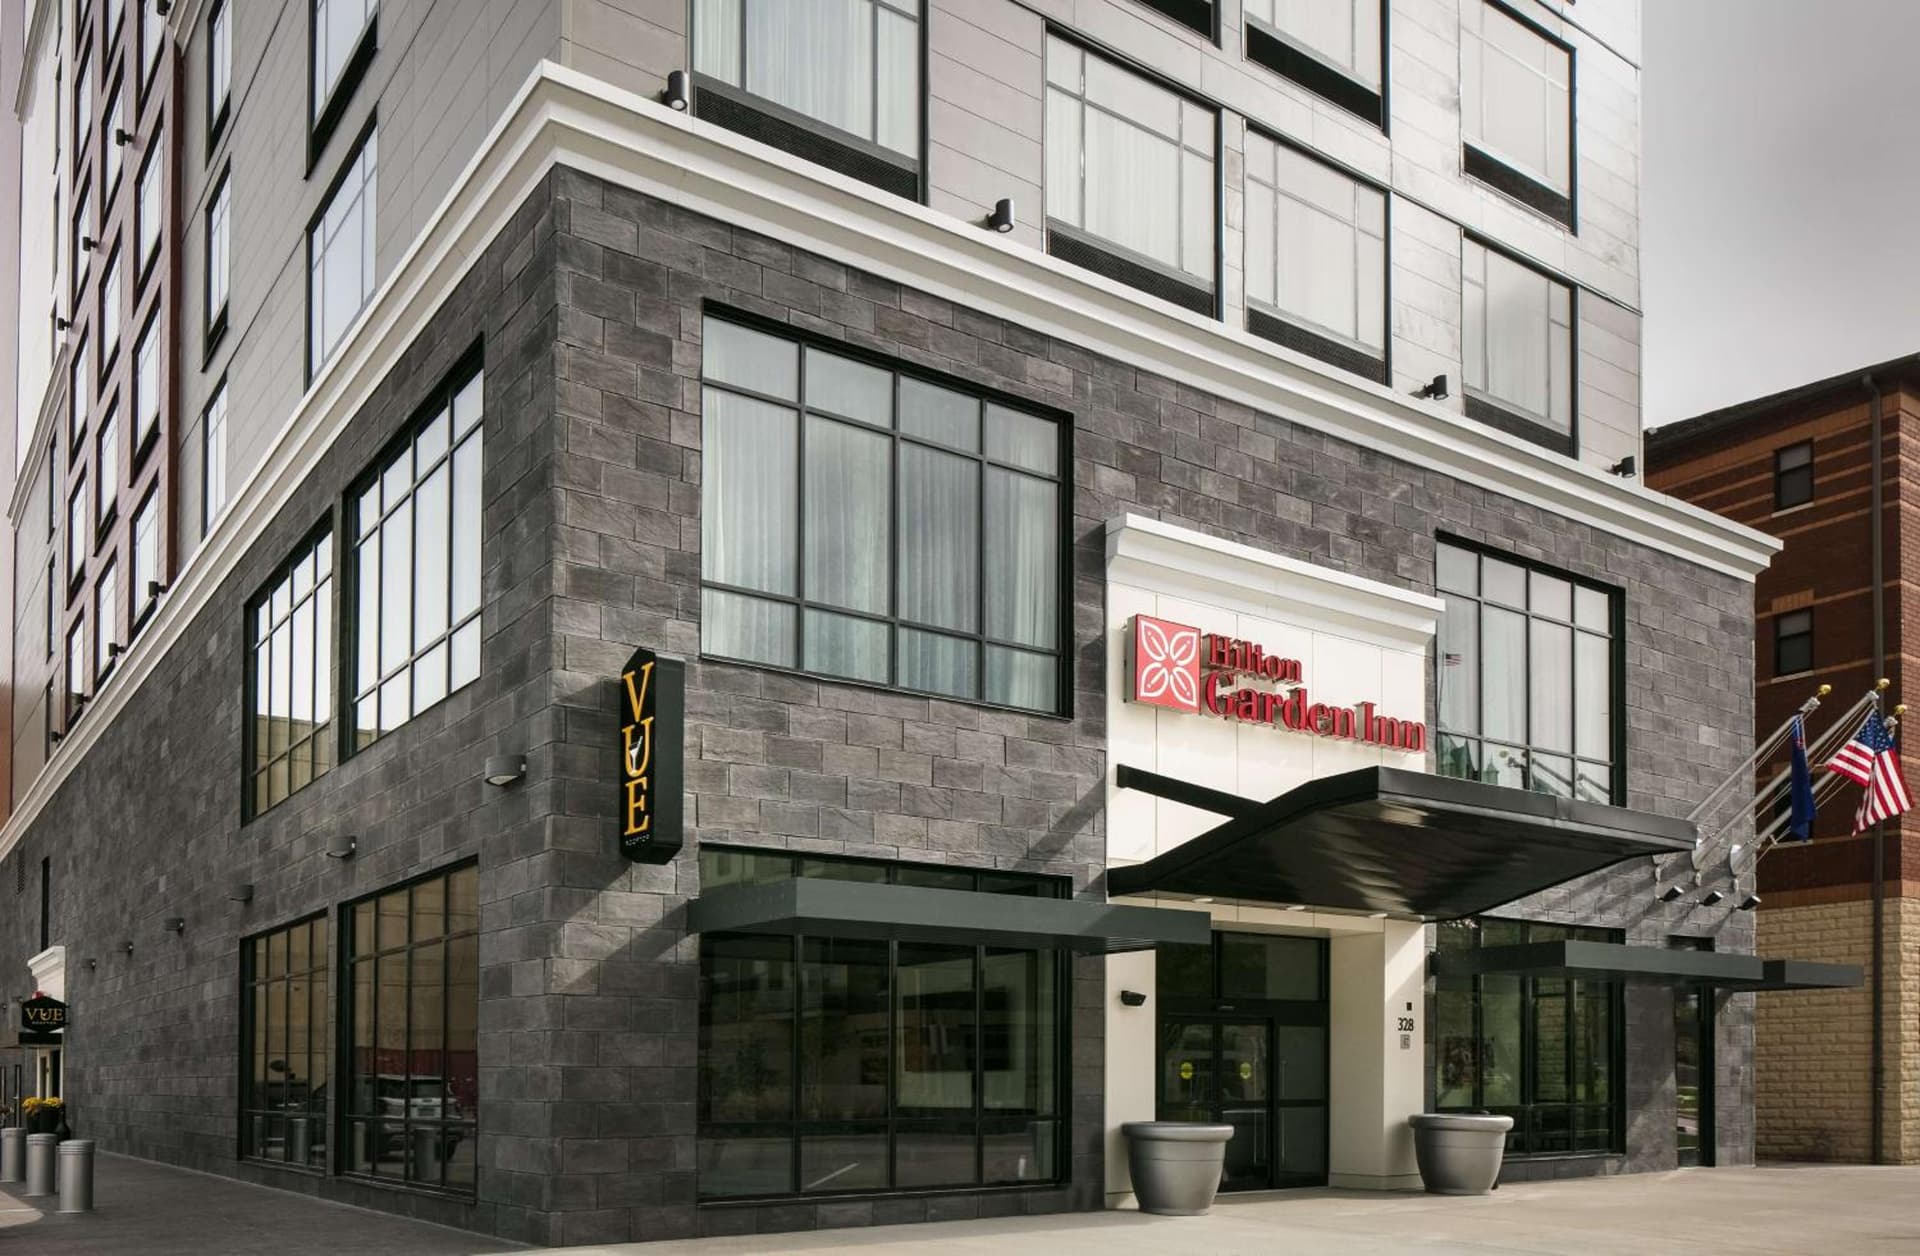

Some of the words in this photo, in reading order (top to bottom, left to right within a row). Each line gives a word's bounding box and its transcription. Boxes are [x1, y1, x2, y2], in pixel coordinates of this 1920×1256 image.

[1204, 634, 1303, 683] Hilton
[1205, 671, 1358, 739] Garden
[1359, 702, 1427, 751] Inn
[622, 661, 655, 836] VUE
[25, 1008, 64, 1021] VUE
[1397, 1017, 1414, 1031] 328
